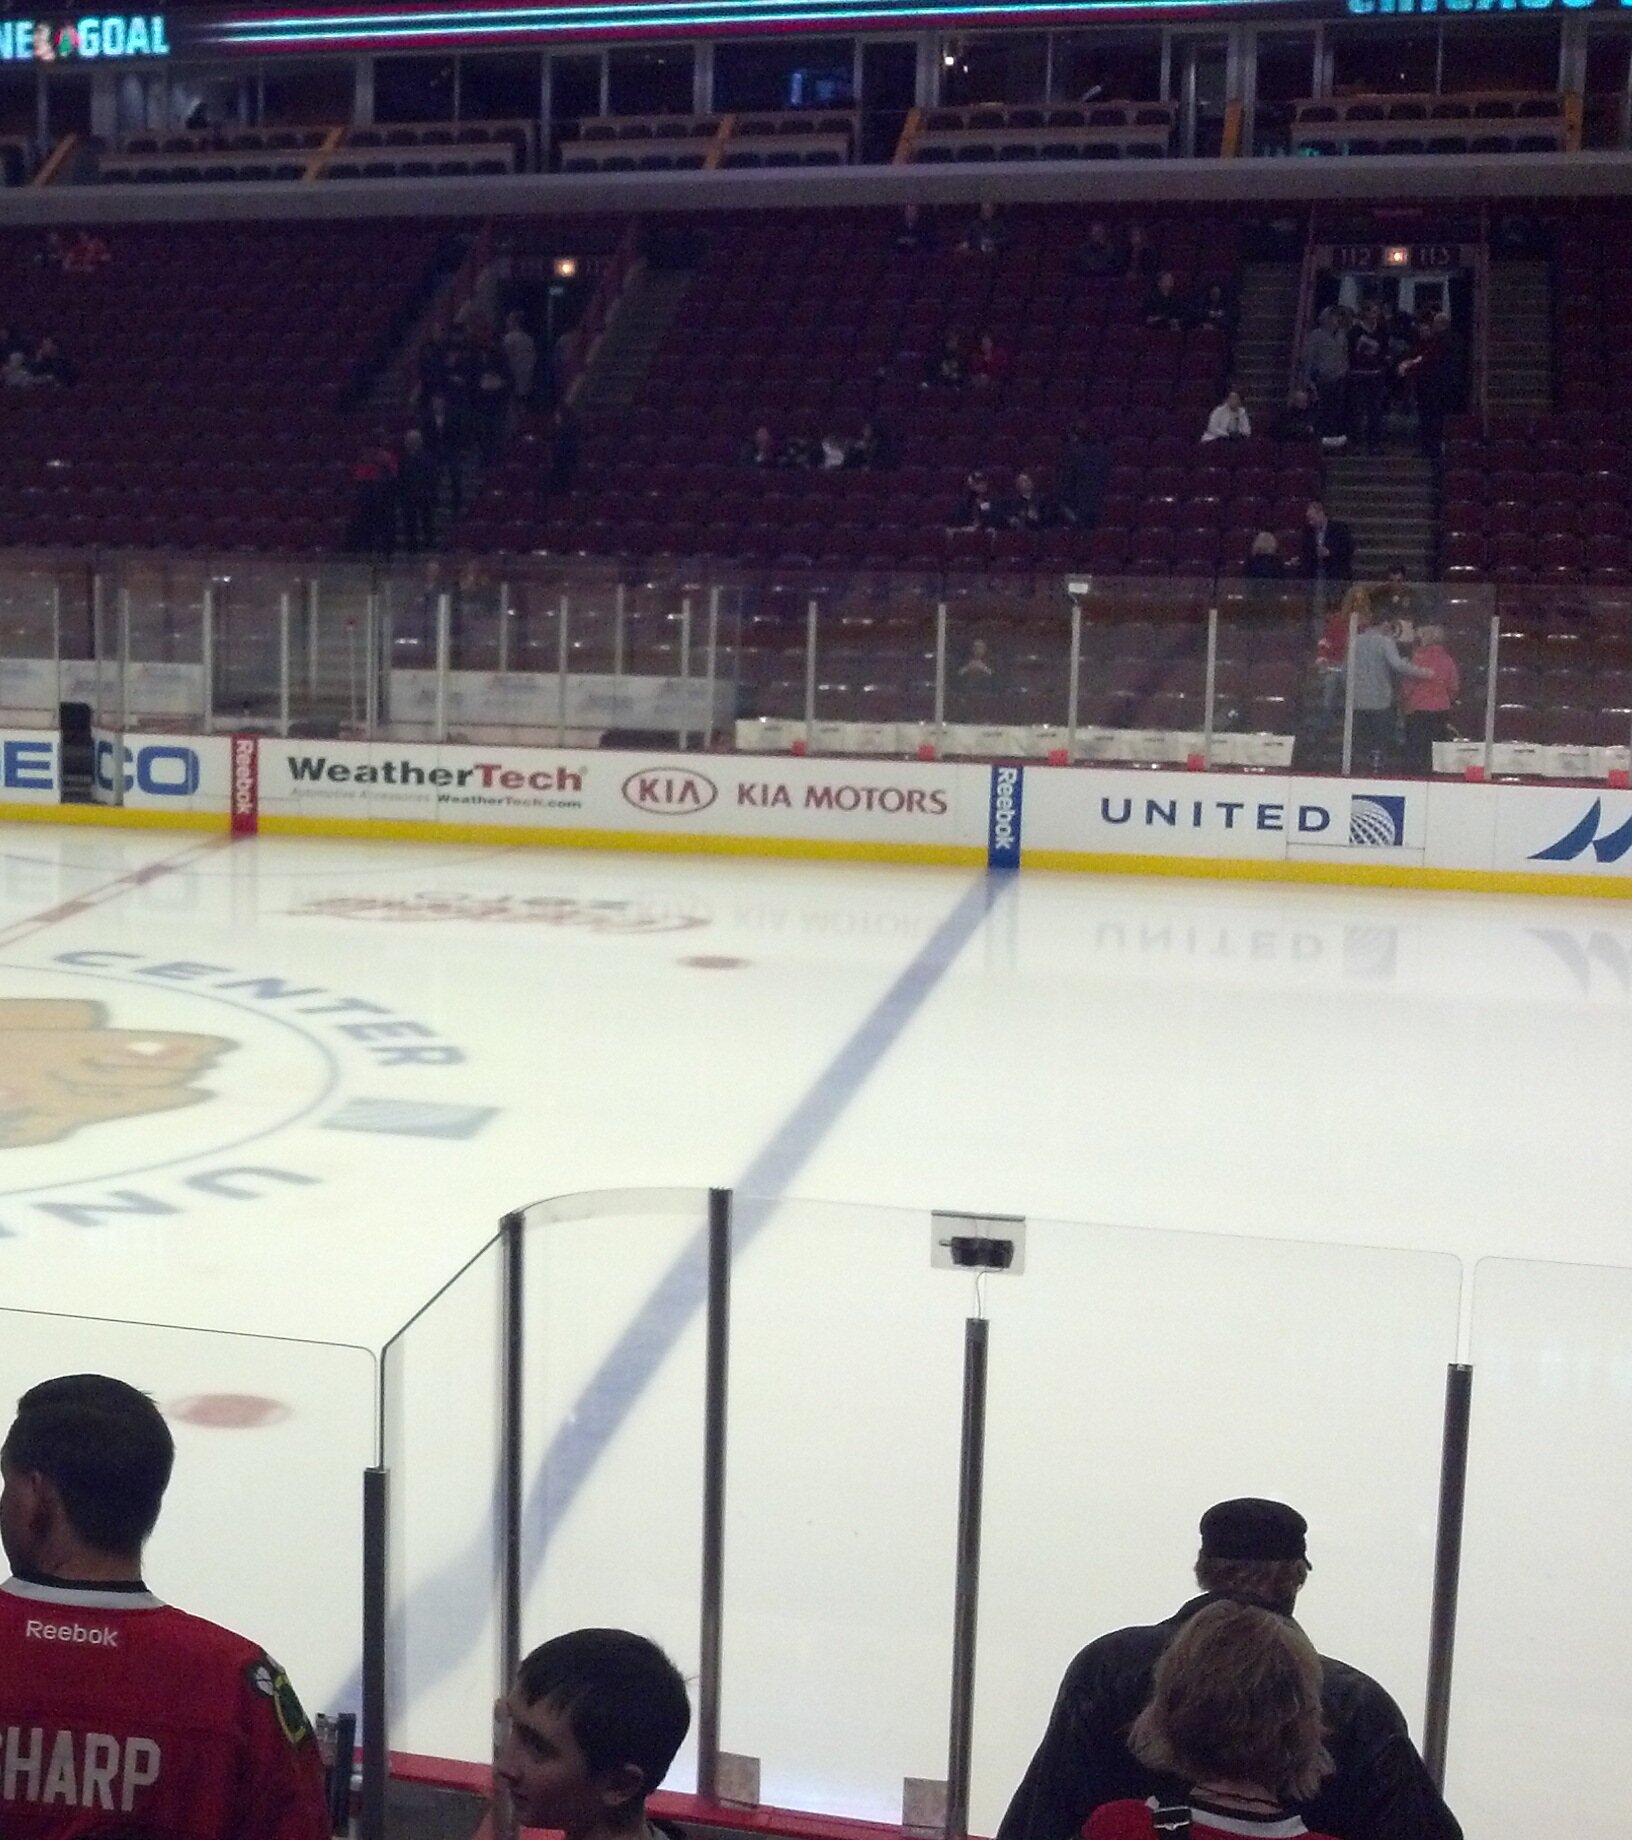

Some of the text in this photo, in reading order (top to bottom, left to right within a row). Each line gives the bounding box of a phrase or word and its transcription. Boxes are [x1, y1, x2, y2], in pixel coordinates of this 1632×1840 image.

[78, 16, 170, 57] GOAL
[236, 739, 254, 815] Reebok
[288, 756, 583, 791] WeatherTech
[639, 778, 701, 805] KIA
[737, 782, 948, 815] KIA MOTORS
[995, 768, 1017, 850] Reebok
[1101, 798, 1330, 832] UNITED
[53, 950, 466, 1066] CENTER
[26, 1619, 119, 1648] Reebok
